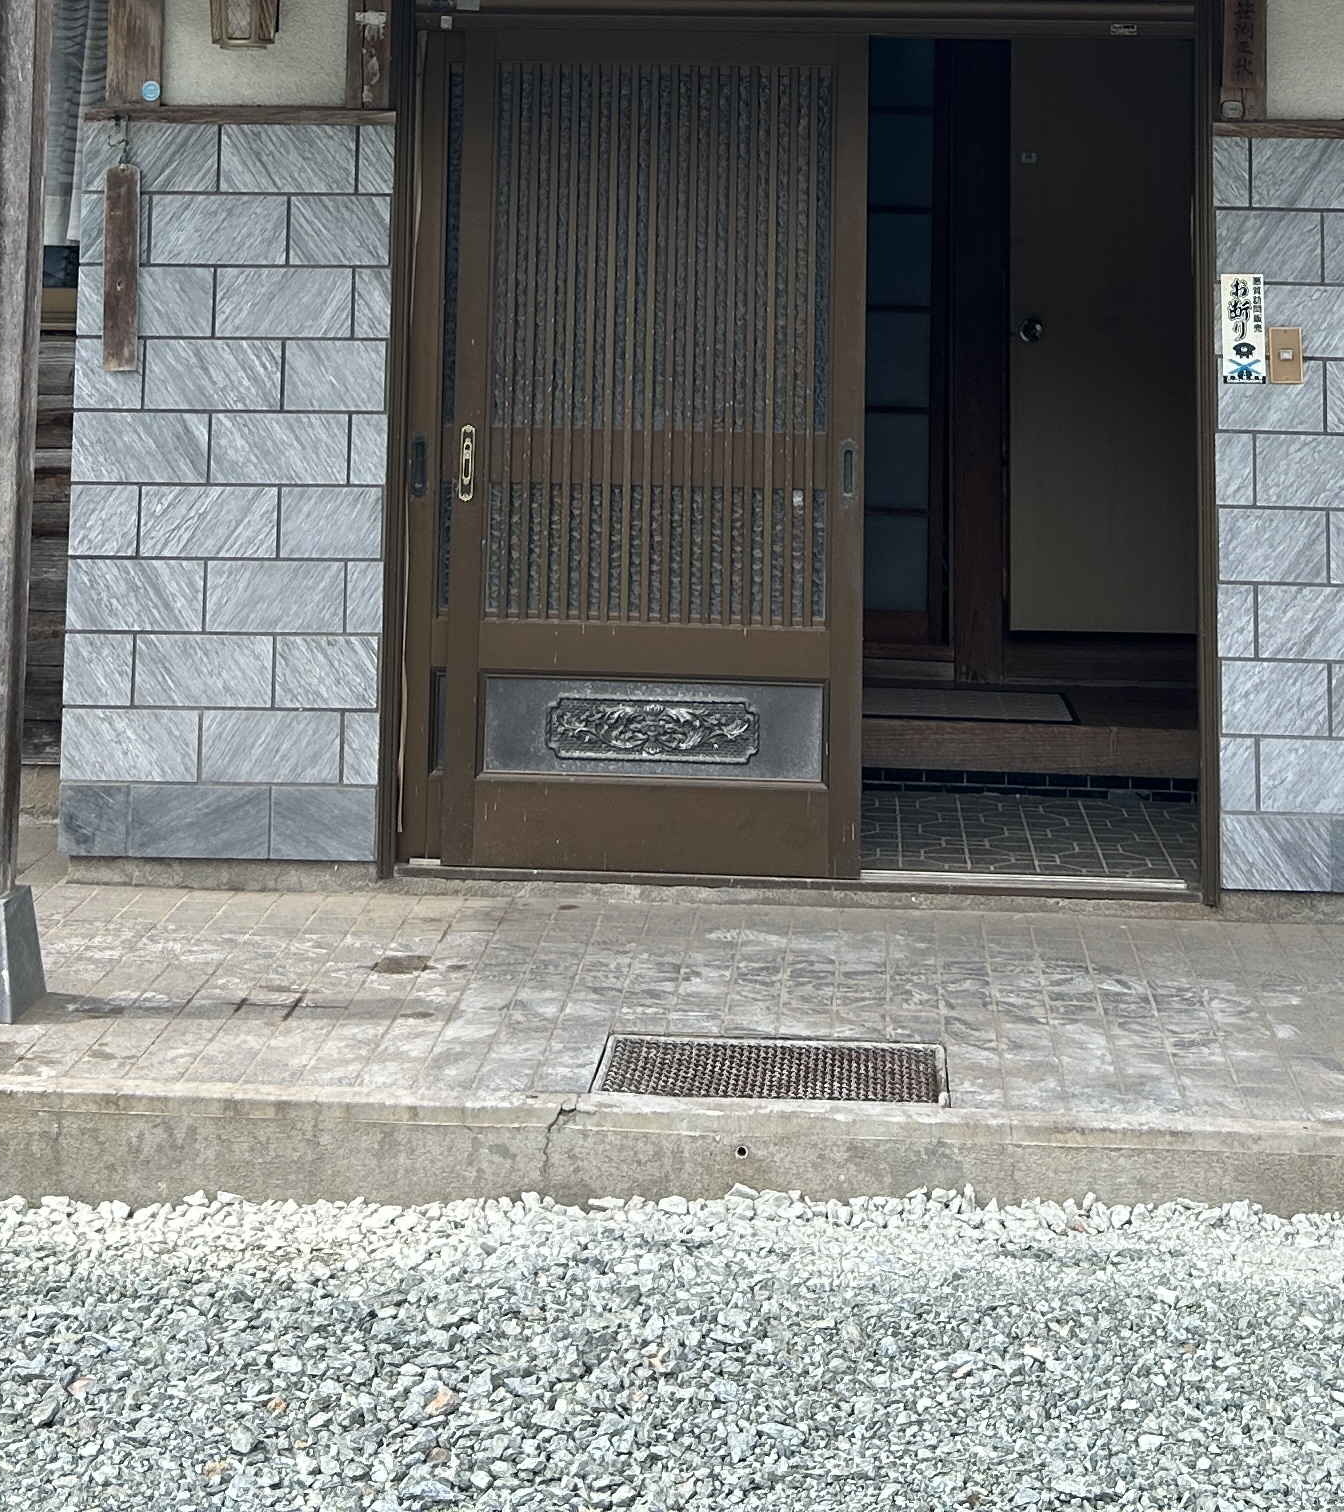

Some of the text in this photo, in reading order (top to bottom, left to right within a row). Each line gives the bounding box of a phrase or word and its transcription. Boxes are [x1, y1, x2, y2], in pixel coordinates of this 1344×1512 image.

[1228, 278, 1252, 342] お断り
[1253, 277, 1262, 333] 悪質訪問販売
